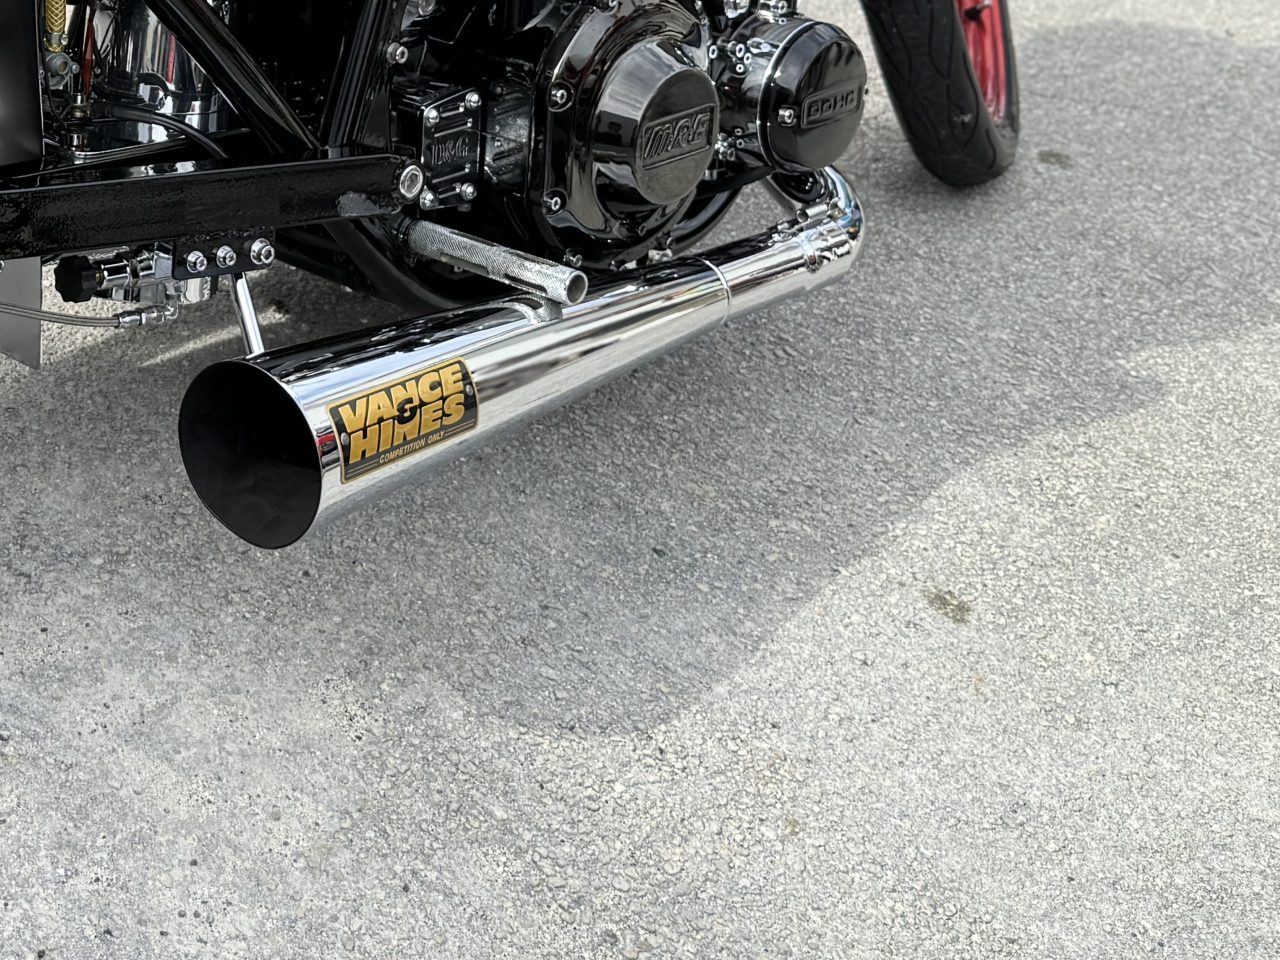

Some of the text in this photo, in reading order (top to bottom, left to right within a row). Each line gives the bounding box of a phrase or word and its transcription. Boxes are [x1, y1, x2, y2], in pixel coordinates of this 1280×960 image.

[338, 363, 464, 433] VANCE
[348, 393, 465, 464] HINES
[379, 430, 447, 464] COMPETITION ONLY
